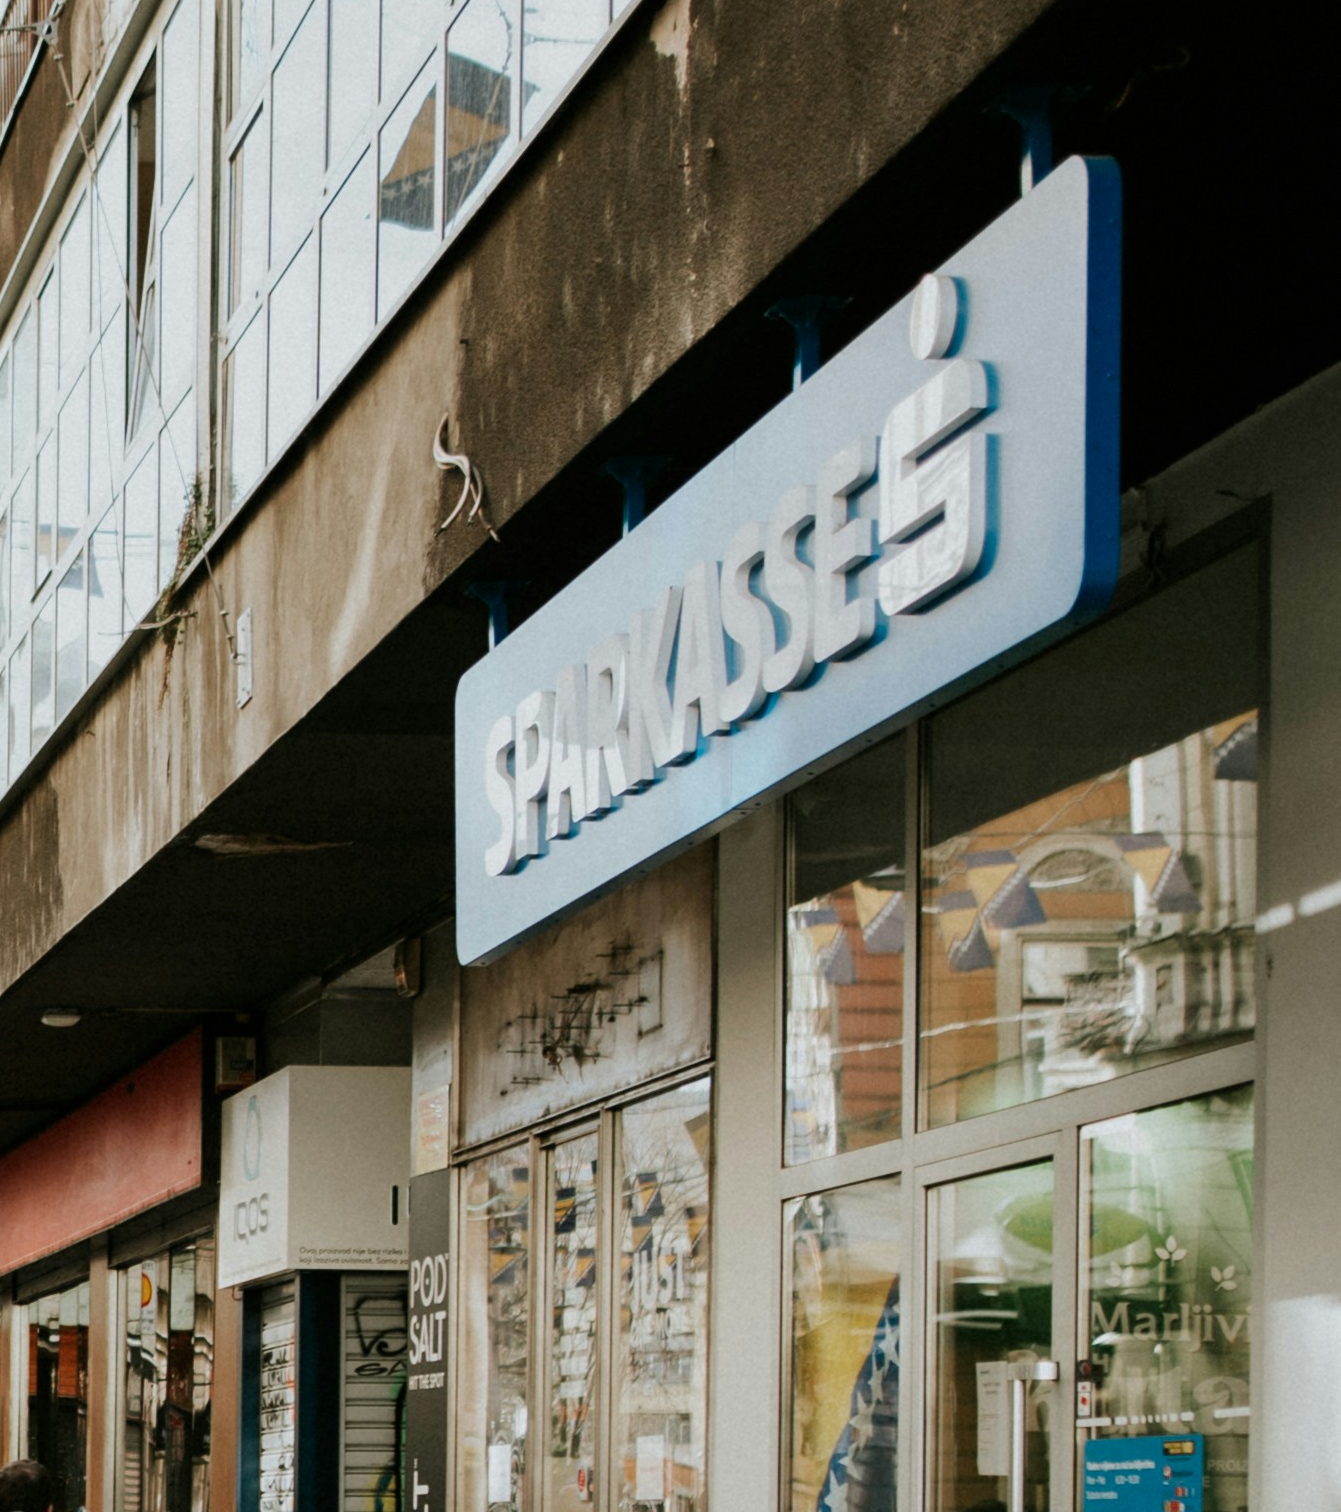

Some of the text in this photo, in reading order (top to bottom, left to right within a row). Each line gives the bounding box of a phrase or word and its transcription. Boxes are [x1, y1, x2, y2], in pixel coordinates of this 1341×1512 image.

[484, 434, 881, 877] SPARKASSE
[233, 1192, 270, 1245] IQOS
[409, 1310, 447, 1365] SALT
